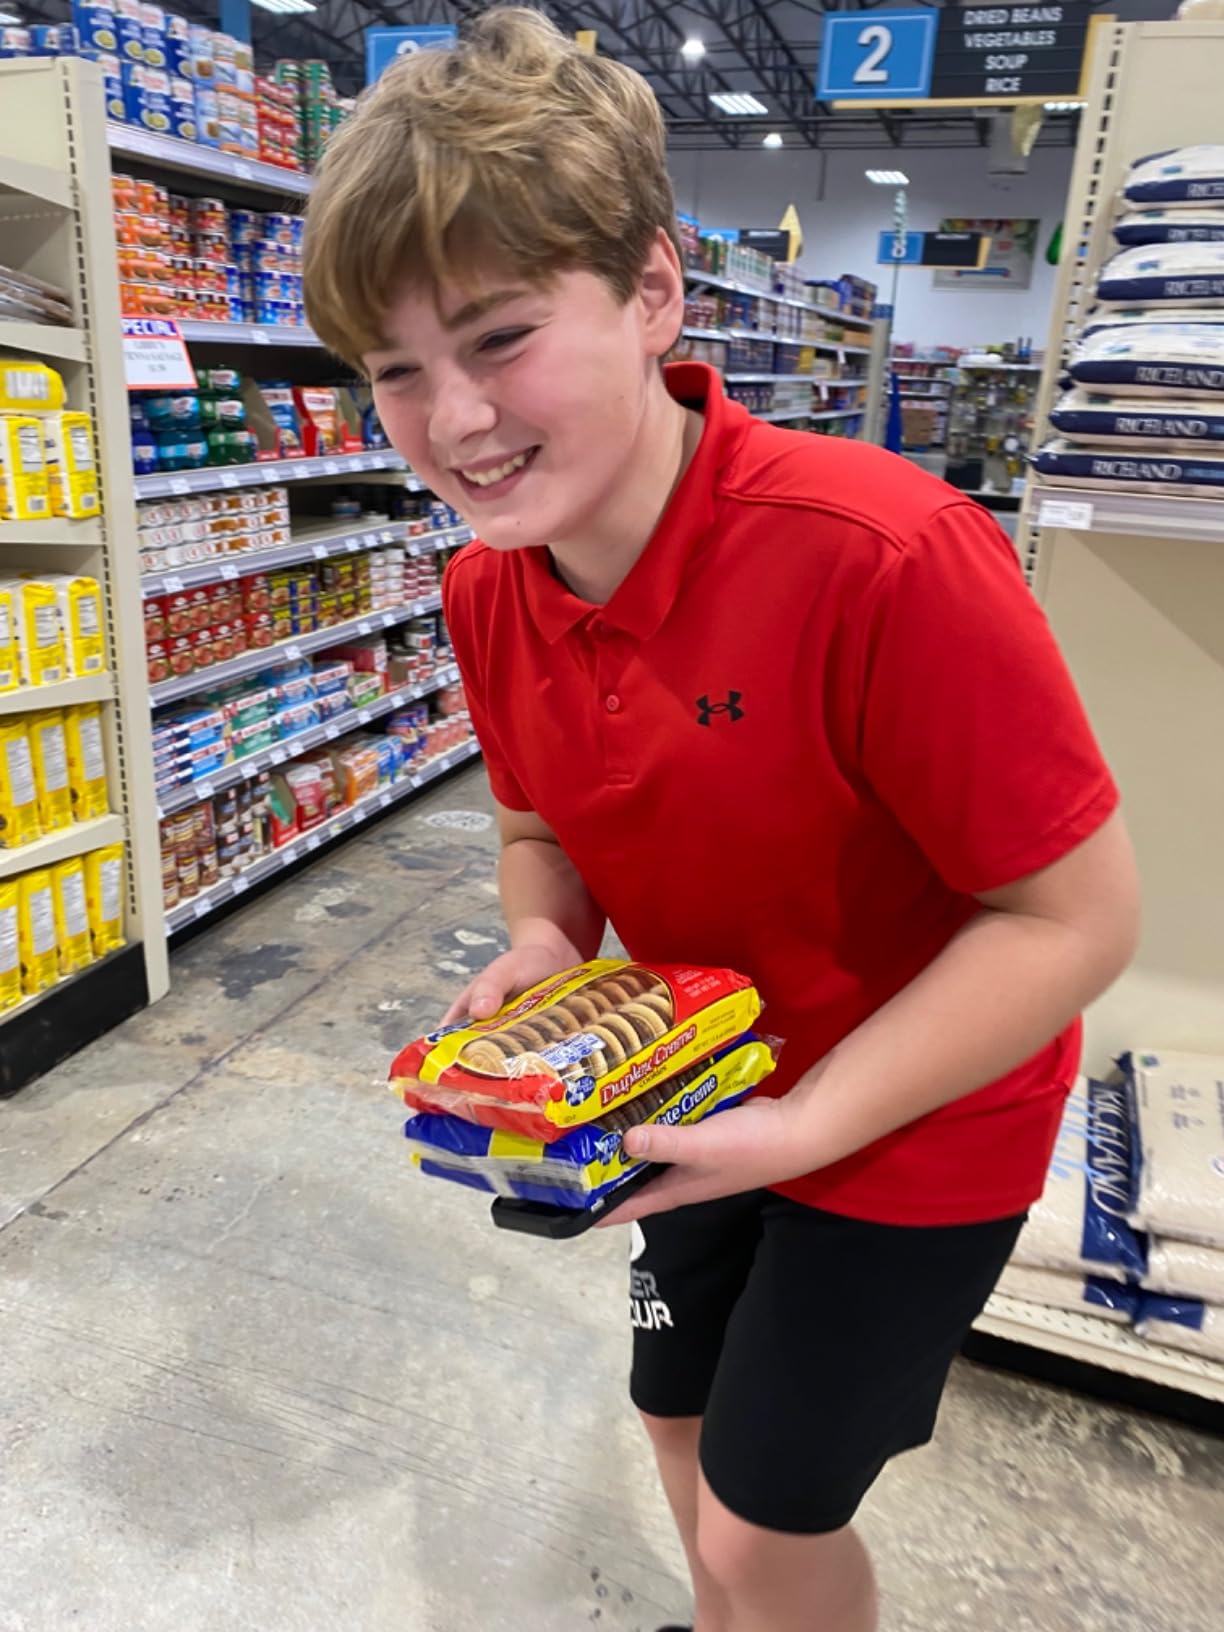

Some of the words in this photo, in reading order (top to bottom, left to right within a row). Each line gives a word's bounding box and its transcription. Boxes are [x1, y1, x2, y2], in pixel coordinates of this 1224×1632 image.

[963, 9, 1009, 25] DRIED
[1011, 6, 1063, 23] BEANS
[964, 30, 1057, 48] VEGETABLES
[853, 25, 893, 84] 2
[985, 54, 1029, 70] SOUP
[985, 77, 1022, 92] RICE
[1115, 417, 1208, 436] RICELAND
[1092, 460, 1182, 480] RICELAND
[601, 1059, 654, 1105] Duplex
[654, 1025, 697, 1067] Creme
[681, 1075, 717, 1113] Creme
